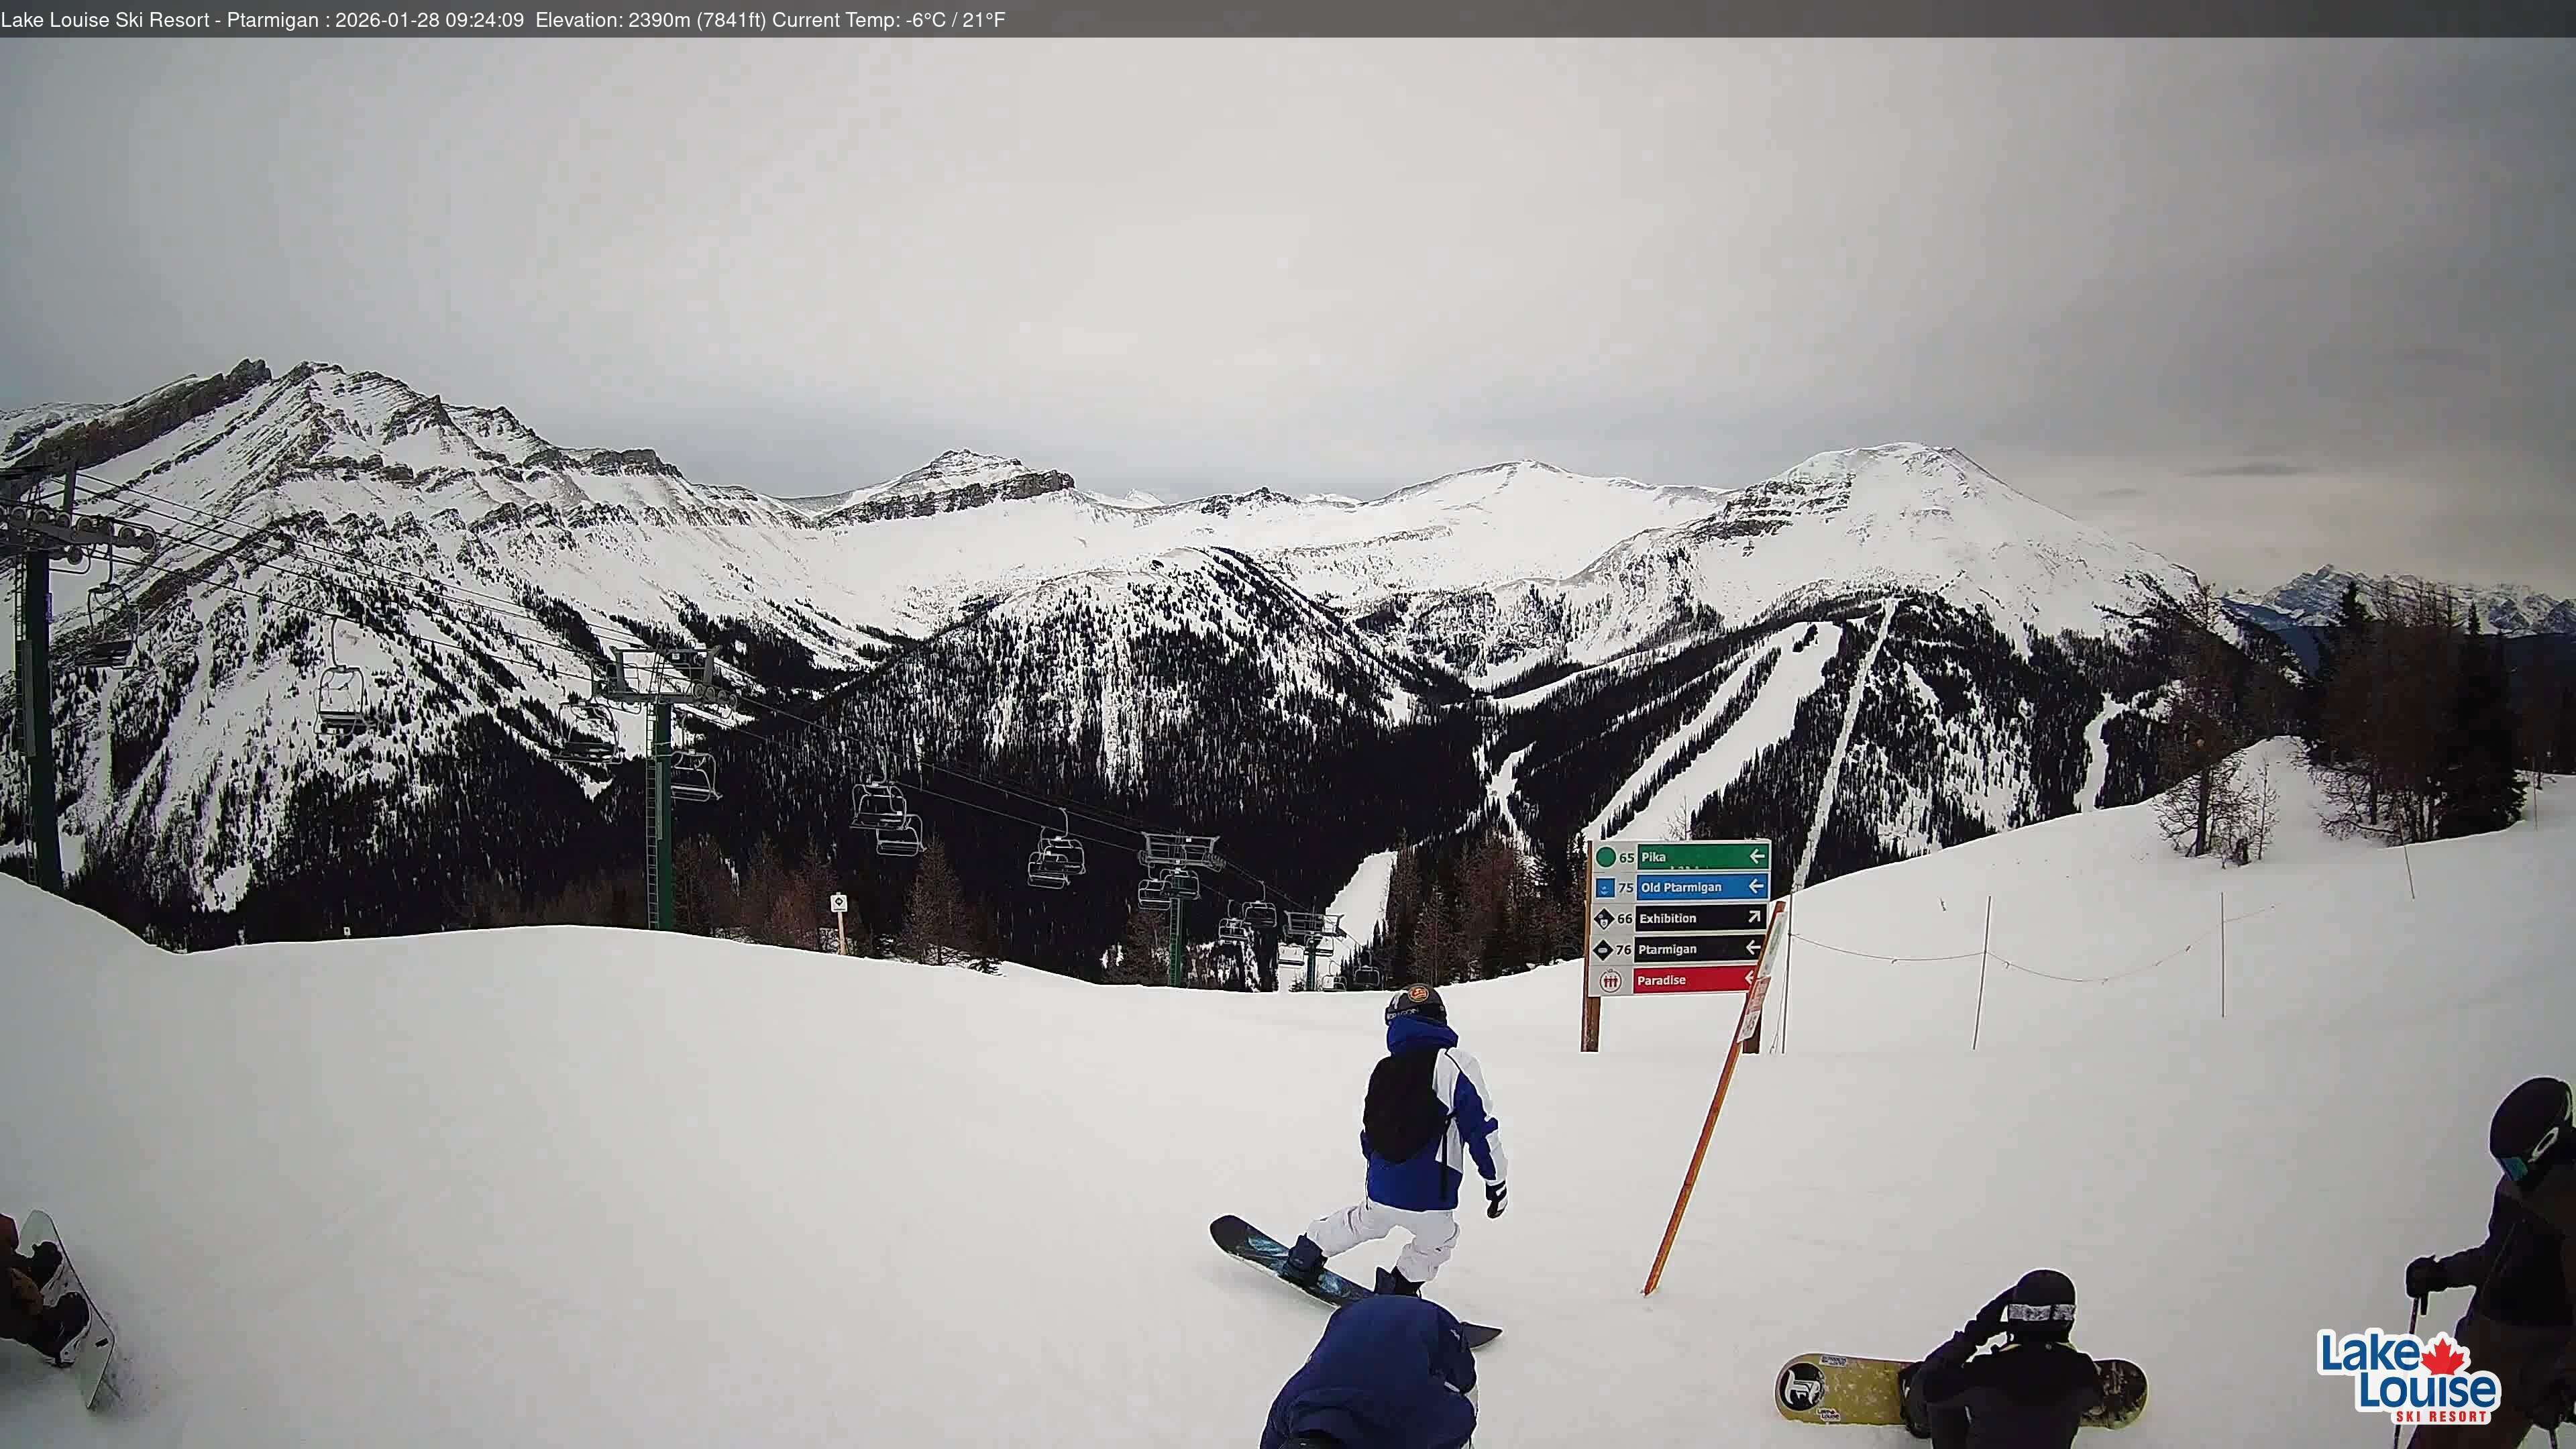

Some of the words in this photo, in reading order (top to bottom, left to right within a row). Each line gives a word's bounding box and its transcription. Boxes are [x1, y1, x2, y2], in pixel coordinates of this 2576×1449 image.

[1619, 853, 1635, 863] 65
[1642, 851, 1666, 863] Pika
[1618, 883, 1634, 894] 75
[1642, 882, 1660, 893] Old
[1664, 882, 1722, 894] Ptarmigan
[1617, 914, 1633, 924] 66
[1640, 913, 1697, 924] Exhibition
[1616, 945, 1631, 955] 76
[1639, 944, 1697, 956] Ptarmigan
[1638, 975, 1686, 985] Paradise
